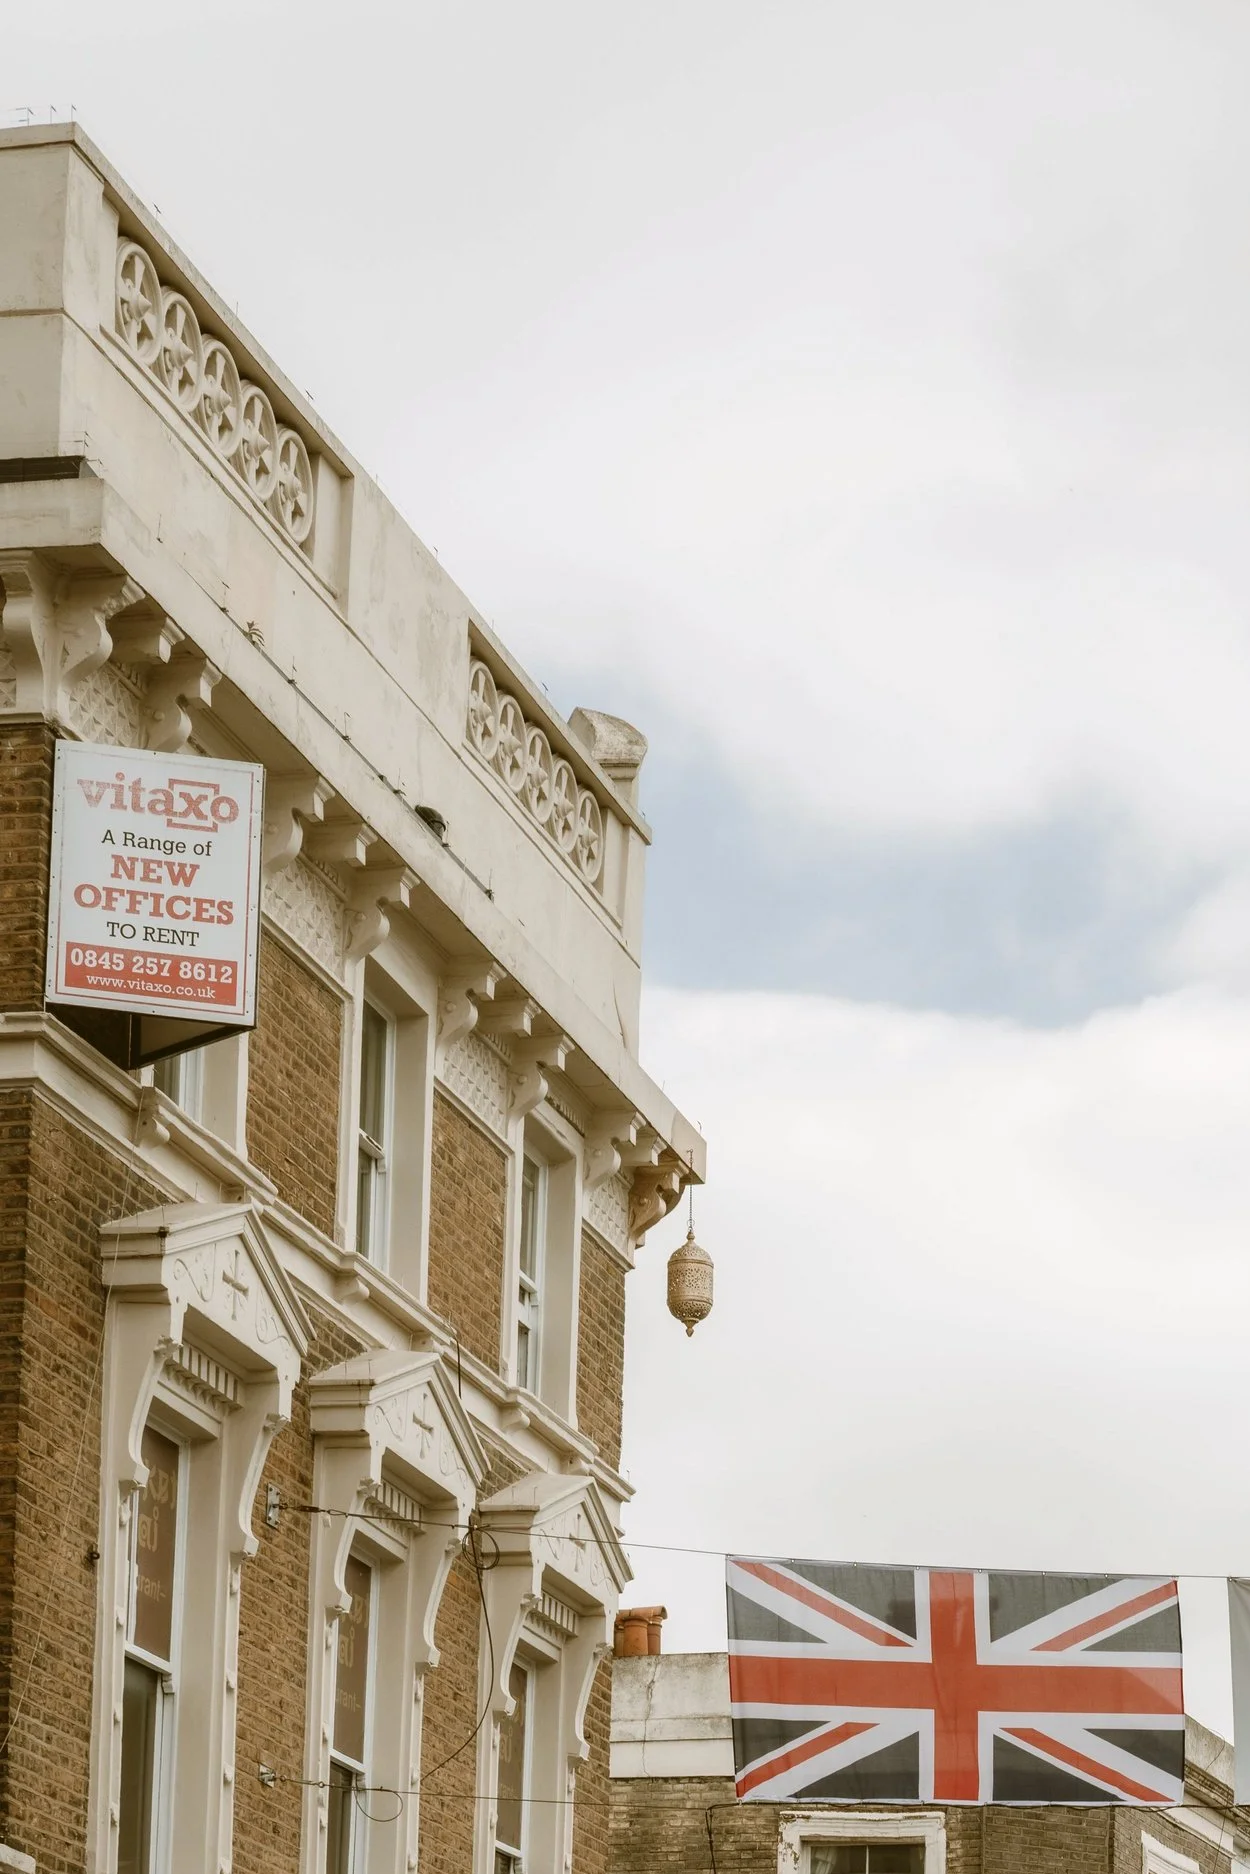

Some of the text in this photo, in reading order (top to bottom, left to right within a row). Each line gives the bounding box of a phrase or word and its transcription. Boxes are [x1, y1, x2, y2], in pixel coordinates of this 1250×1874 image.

[77, 772, 240, 826] vitaxo
[102, 830, 212, 857] A Range of
[111, 854, 200, 888] NEW
[74, 883, 234, 925] OFFICES
[107, 921, 200, 947] TO RENT
[70, 948, 233, 984] 0845 257 8612
[86, 973, 216, 999] www.vitaxo.co.uk
